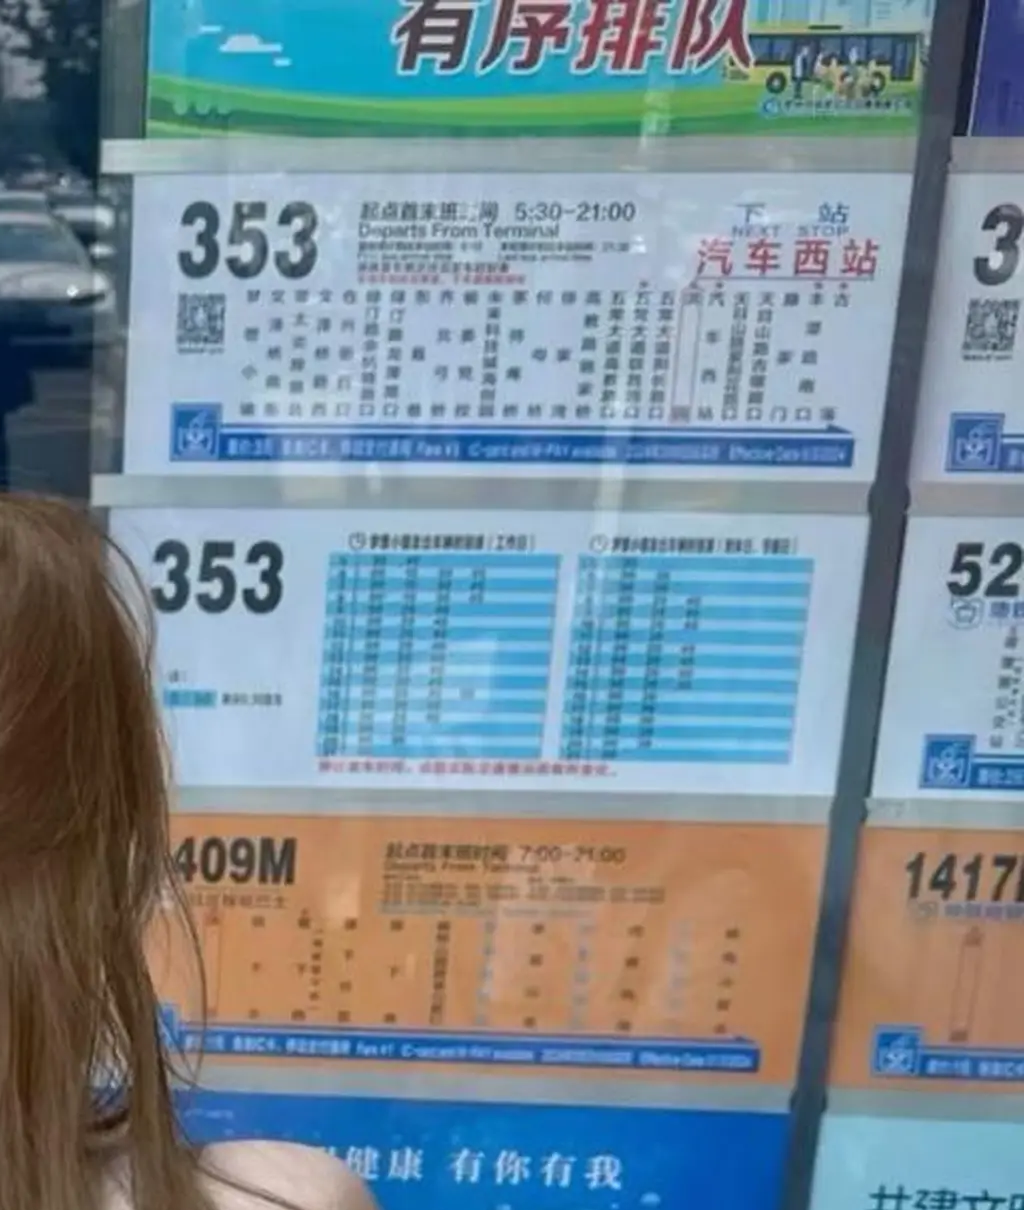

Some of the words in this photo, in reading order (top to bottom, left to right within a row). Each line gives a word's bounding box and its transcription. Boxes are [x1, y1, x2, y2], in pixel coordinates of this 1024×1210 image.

[393, 0, 757, 76] 有序排队
[178, 201, 319, 279] 353
[432, 221, 478, 238] From
[484, 221, 560, 238] Terminal
[514, 202, 637, 222] 5:30-21:00
[697, 238, 879, 276] 汽车西站
[973, 203, 1024, 286] 3
[150, 539, 283, 614] 353
[947, 541, 1024, 597] 52
[322, 1145, 423, 1181] 健康
[449, 1147, 623, 1191] 有你有我
